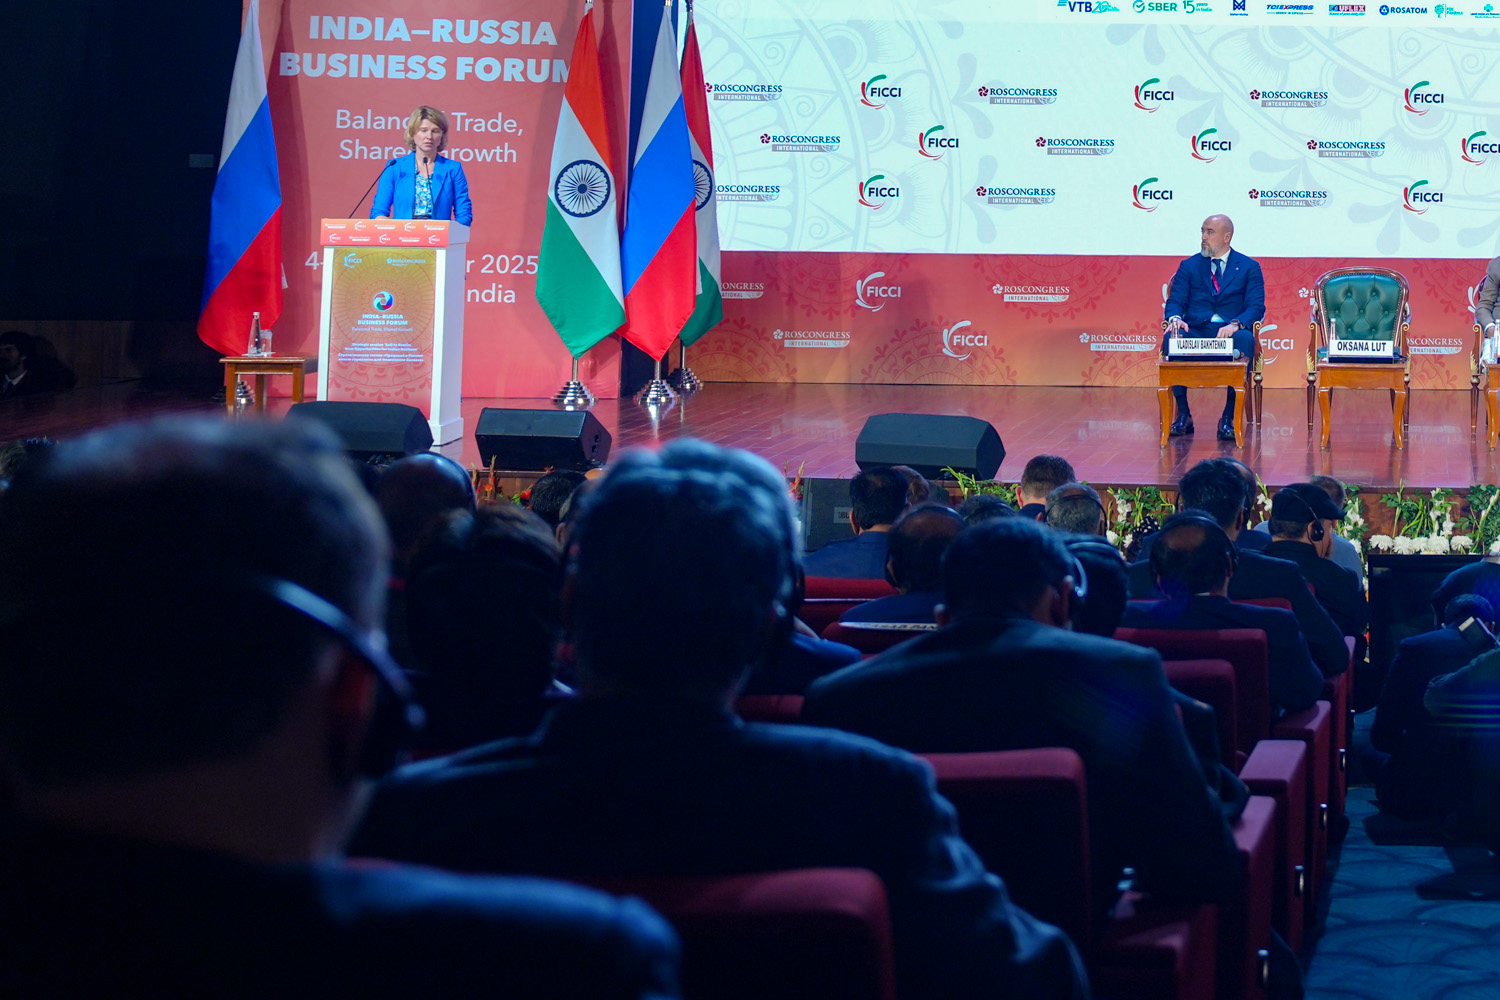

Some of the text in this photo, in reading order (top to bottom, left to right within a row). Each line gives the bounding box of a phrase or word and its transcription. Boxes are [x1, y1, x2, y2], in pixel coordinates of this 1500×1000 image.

[1068, 2, 1092, 12] VTB
[1148, 0, 1195, 14] SBER 15
[279, 52, 446, 80] BUSINESS
[871, 87, 901, 97] FICCI
[1144, 91, 1174, 101] FICCI
[452, 112, 523, 136] Trade,
[928, 138, 959, 148] FICCI
[1201, 141, 1231, 151] FICCI
[339, 139, 517, 162] Share rowth
[716, 185, 780, 193] OSCONGRESS
[868, 188, 899, 197] FICCI
[1142, 190, 1173, 200] FICCI
[481, 254, 538, 274] 2025
[468, 284, 515, 303] ndia
[1004, 285, 1069, 294] ROSCONGRESS
[1090, 333, 1156, 344] ROSCONGRESS
[1177, 340, 1226, 349] VLADISLAV BAKHTENKO
[1337, 341, 1387, 352] OKSANA LUT
